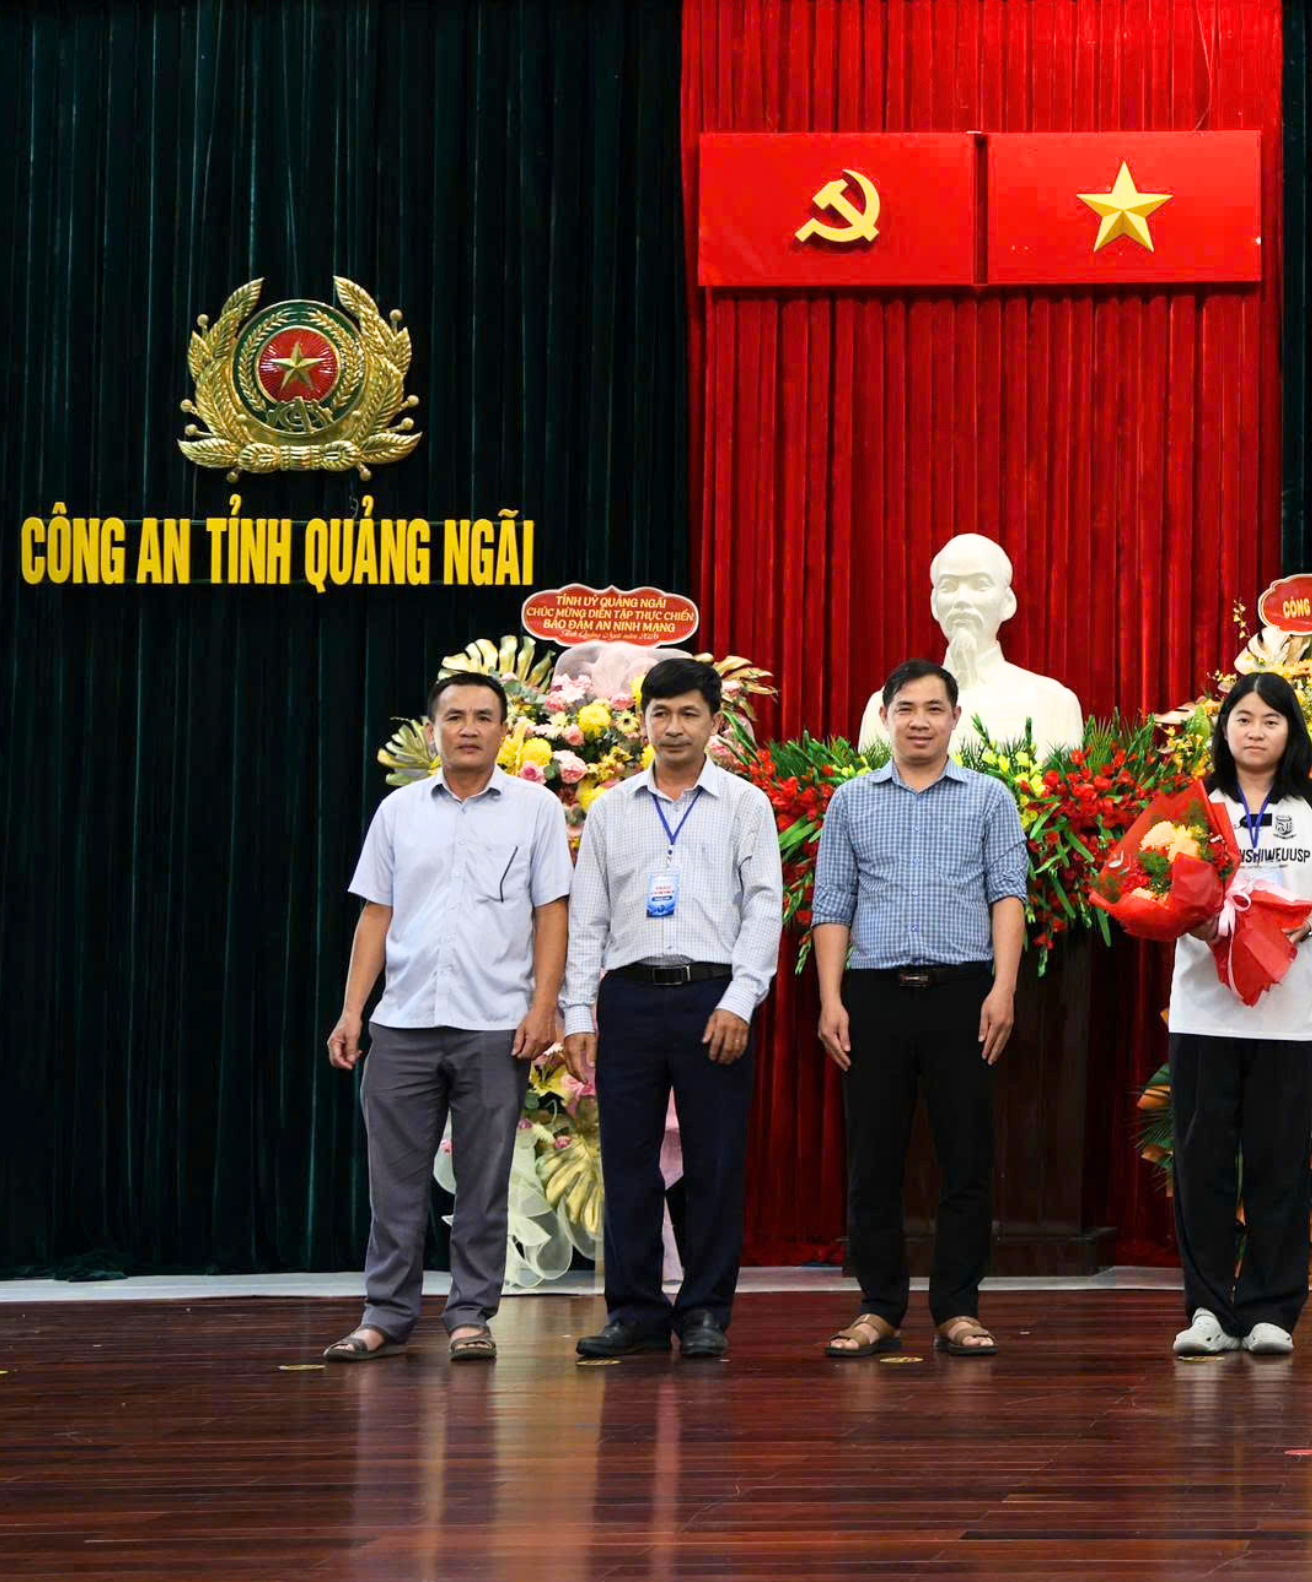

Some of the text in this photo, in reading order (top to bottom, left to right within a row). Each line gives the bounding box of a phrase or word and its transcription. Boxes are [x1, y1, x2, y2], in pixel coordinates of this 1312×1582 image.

[21, 493, 535, 594] CÔNG AN TỈNH QUẢNG NGÃI
[595, 620, 611, 631] AN
[613, 621, 641, 632] NINH
